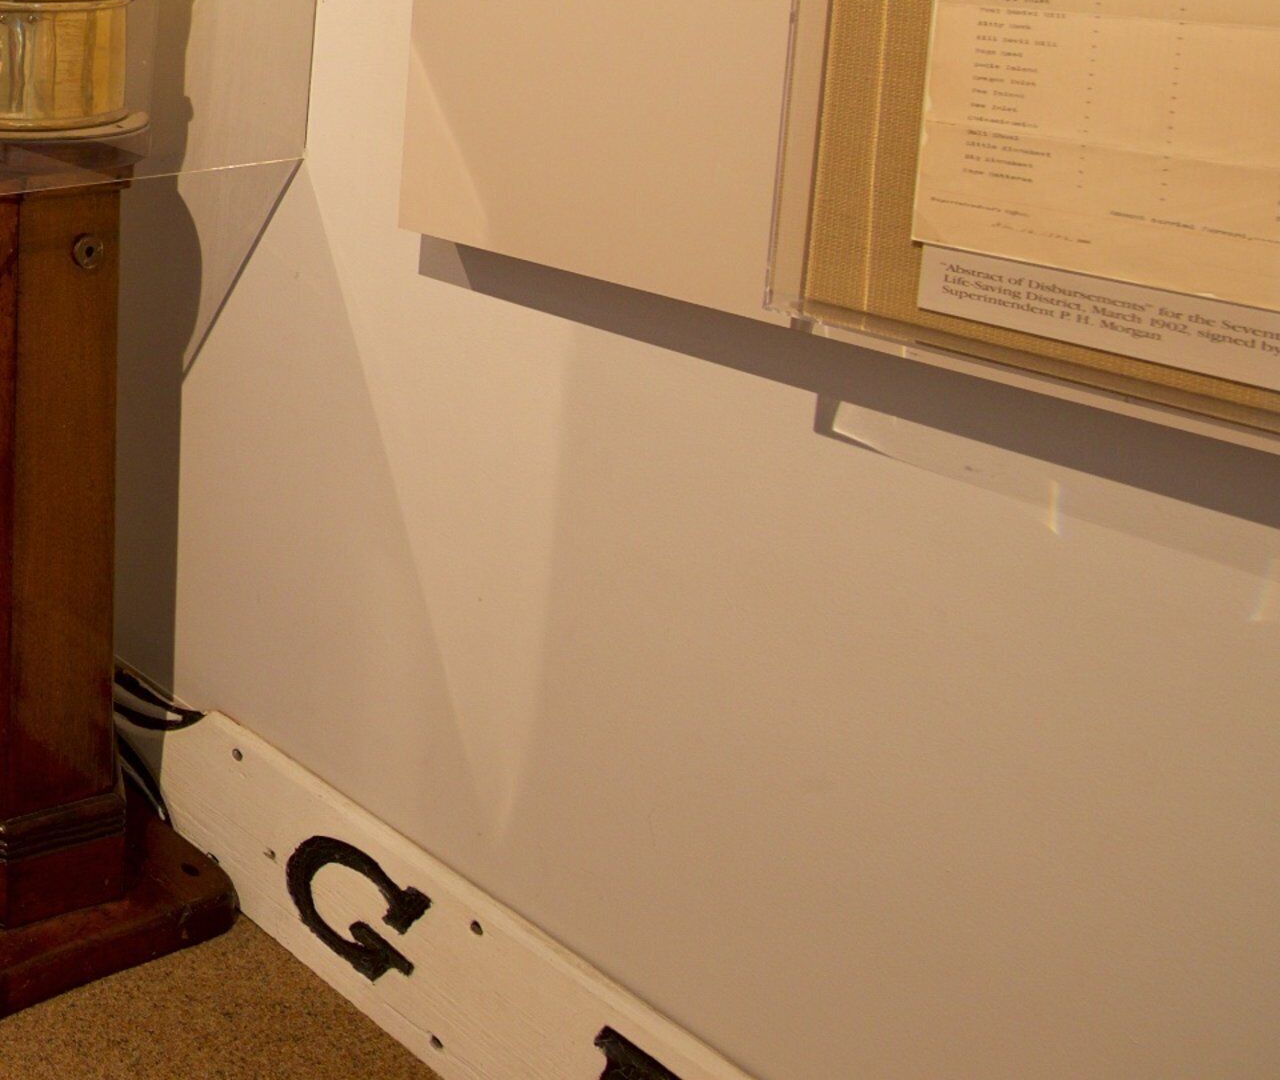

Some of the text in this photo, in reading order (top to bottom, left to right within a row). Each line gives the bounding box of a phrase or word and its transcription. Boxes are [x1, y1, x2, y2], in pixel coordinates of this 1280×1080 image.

[941, 284, 1054, 317] Superintendent
[1099, 319, 1162, 342] Morgan
[943, 273, 1022, 301] Life-Saving
[1091, 305, 1142, 324] March
[1196, 330, 1256, 349] signed
[1007, 276, 1025, 287] of
[1158, 306, 1183, 320] for
[1187, 313, 1216, 327] the
[286, 836, 431, 983] G
